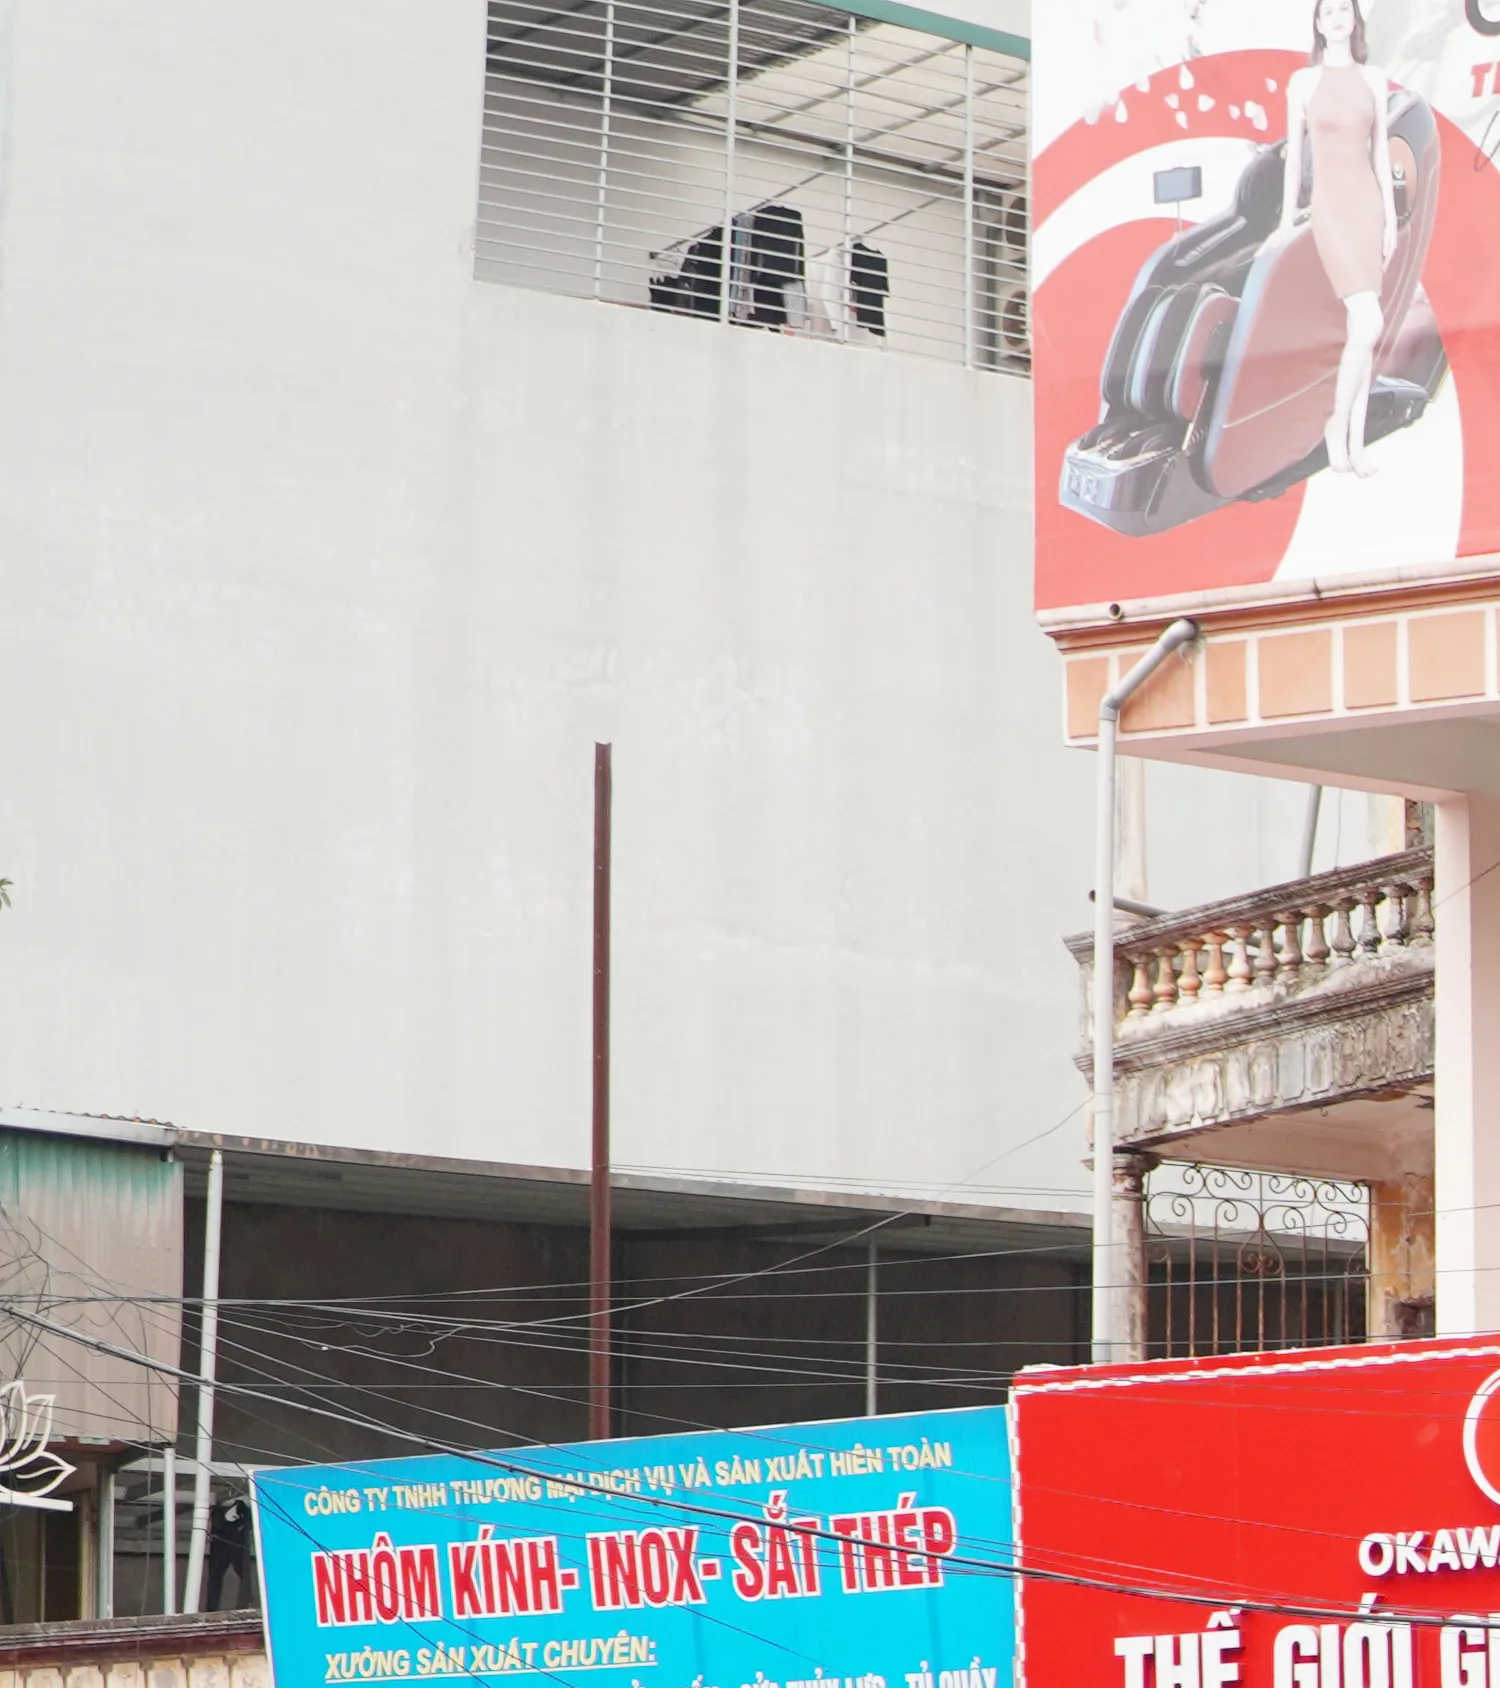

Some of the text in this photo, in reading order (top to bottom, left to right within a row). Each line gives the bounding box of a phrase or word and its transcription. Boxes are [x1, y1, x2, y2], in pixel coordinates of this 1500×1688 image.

[311, 1531, 445, 1629] NHÔM
[732, 1489, 825, 1604] SẮT
[829, 1491, 957, 1593] THÉP
